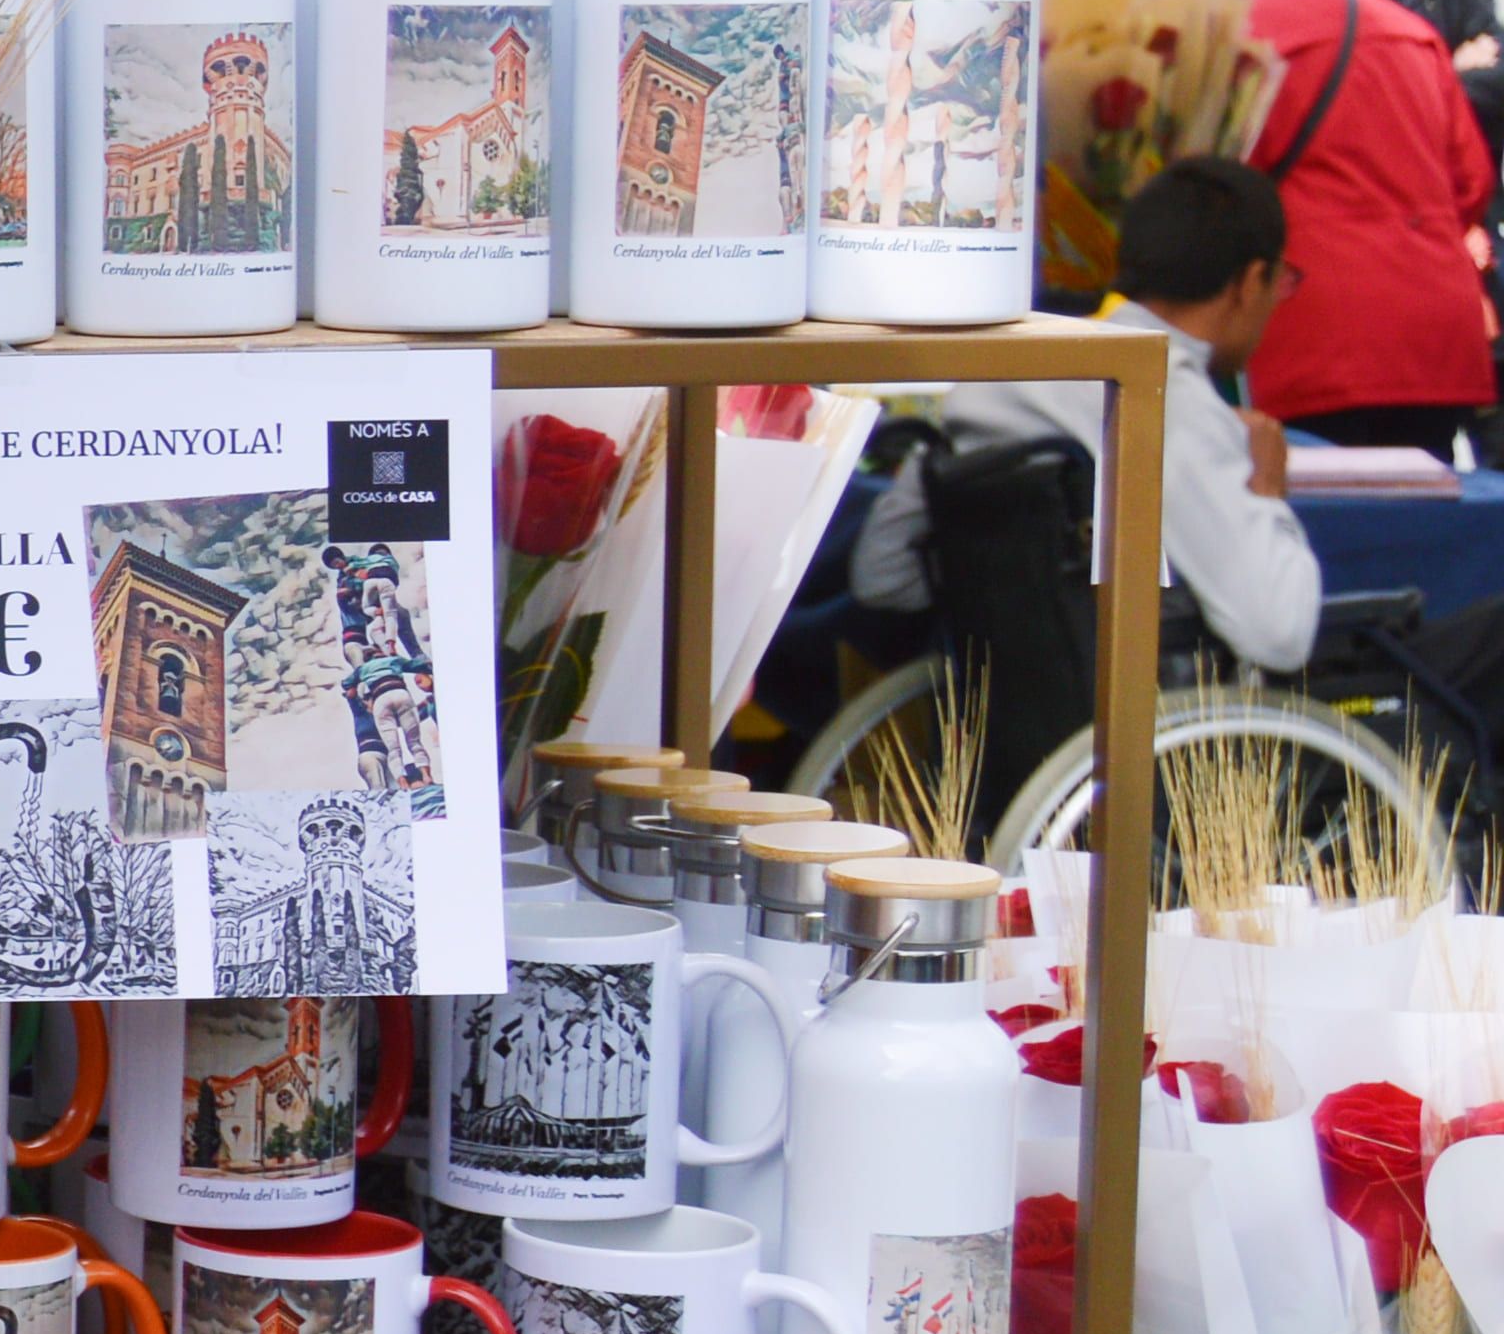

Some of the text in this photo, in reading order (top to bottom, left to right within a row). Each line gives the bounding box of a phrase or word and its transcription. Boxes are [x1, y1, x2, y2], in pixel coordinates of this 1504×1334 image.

[379, 244, 455, 262] Cerdanyola
[459, 246, 479, 259] del
[482, 245, 514, 259] Vallès
[613, 244, 687, 261] Cerdanyola
[692, 245, 712, 258] del
[716, 244, 751, 258] Vallès
[818, 234, 953, 253] Cerdanyola del Vallès
[101, 262, 171, 280] Cerdanyola
[175, 264, 197, 276] del
[199, 263, 235, 276] Vallès
[349, 418, 430, 439] NOMÉS A
[31, 421, 284, 459] CERDANYOLA!
[342, 490, 436, 505] COSAS de CASA
[177, 1183, 250, 1203] Cerdanyola
[254, 1189, 272, 1201] del
[447, 1170, 566, 1200] Cerdanyola del Vallès
